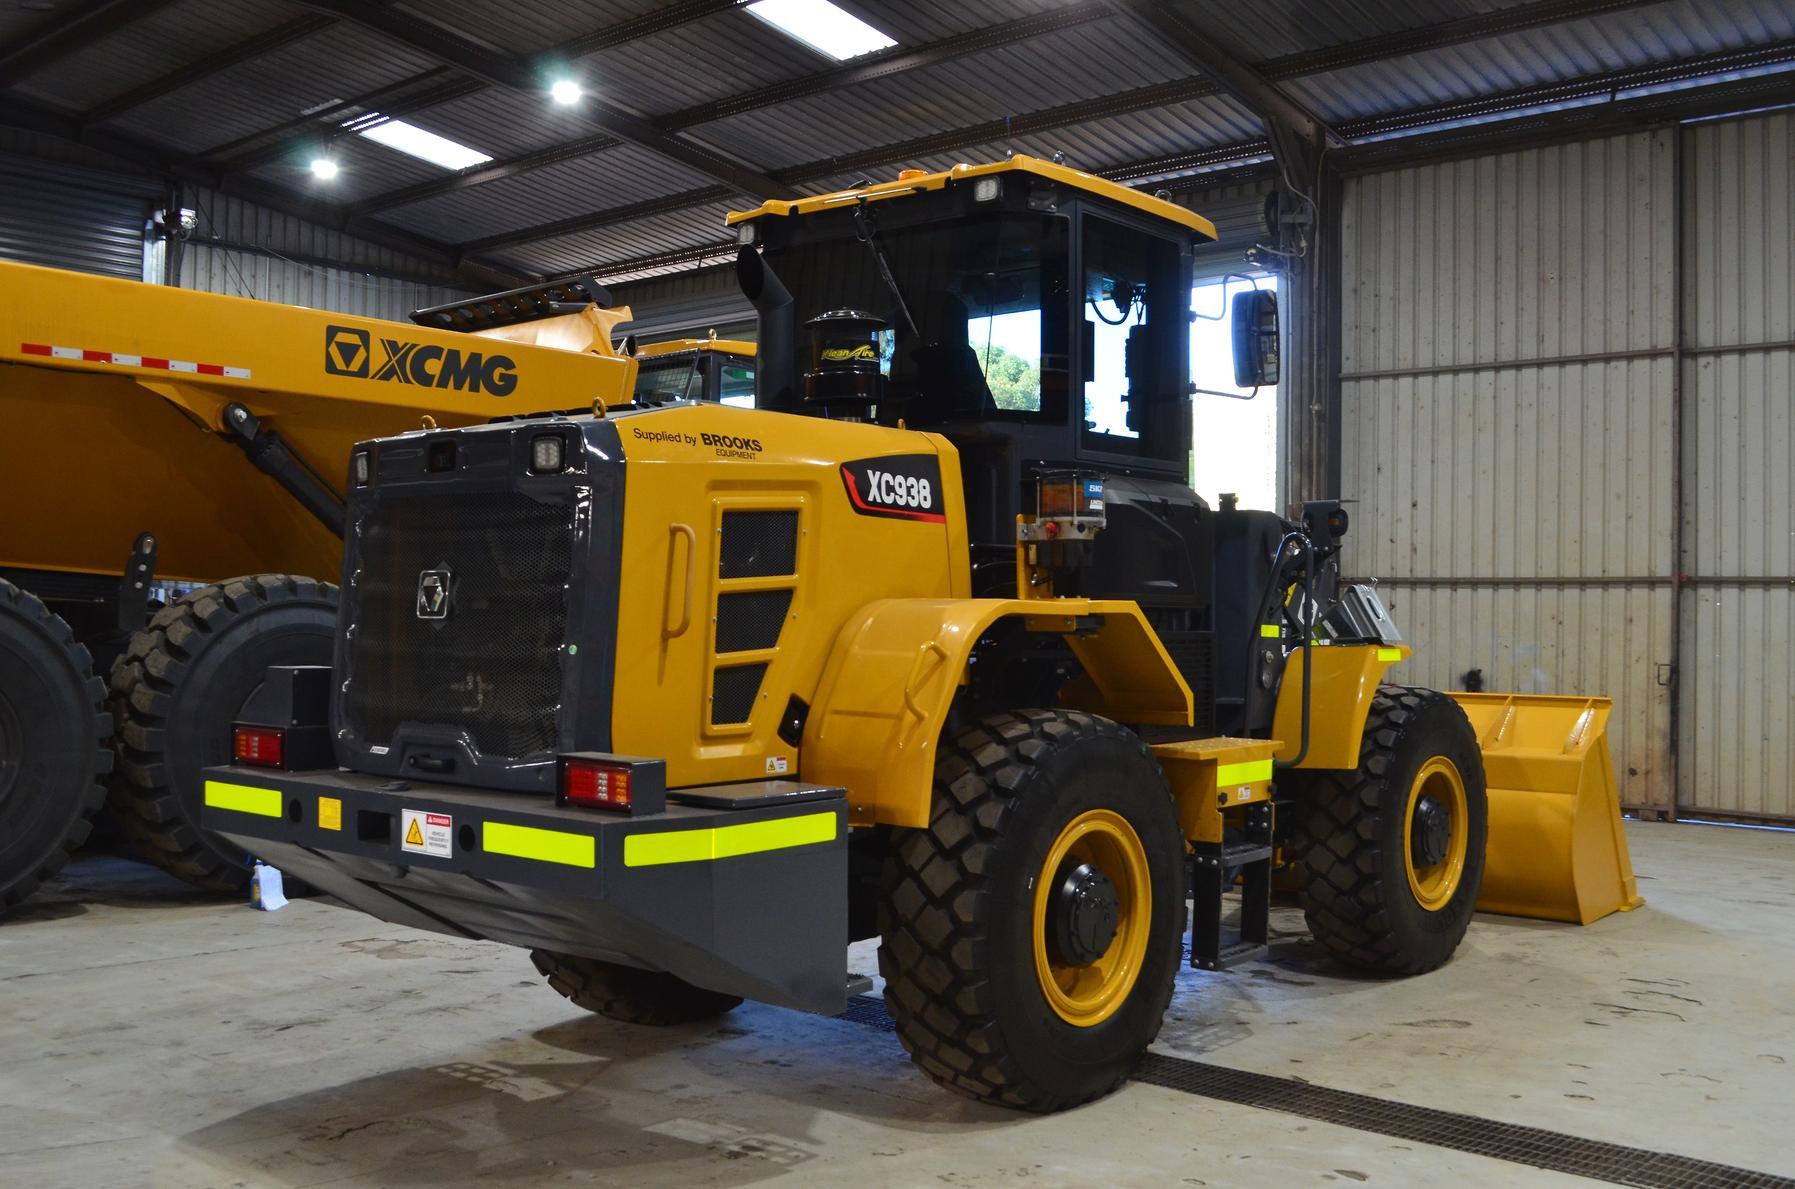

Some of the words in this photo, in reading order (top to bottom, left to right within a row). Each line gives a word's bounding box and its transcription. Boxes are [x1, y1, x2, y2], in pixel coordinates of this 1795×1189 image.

[370, 338, 518, 397] XCMG
[633, 427, 681, 444] Supplied
[684, 433, 697, 447] by
[700, 432, 763, 452] BROOKS
[716, 448, 756, 460] EQUIPMENT
[866, 469, 932, 509] XC938
